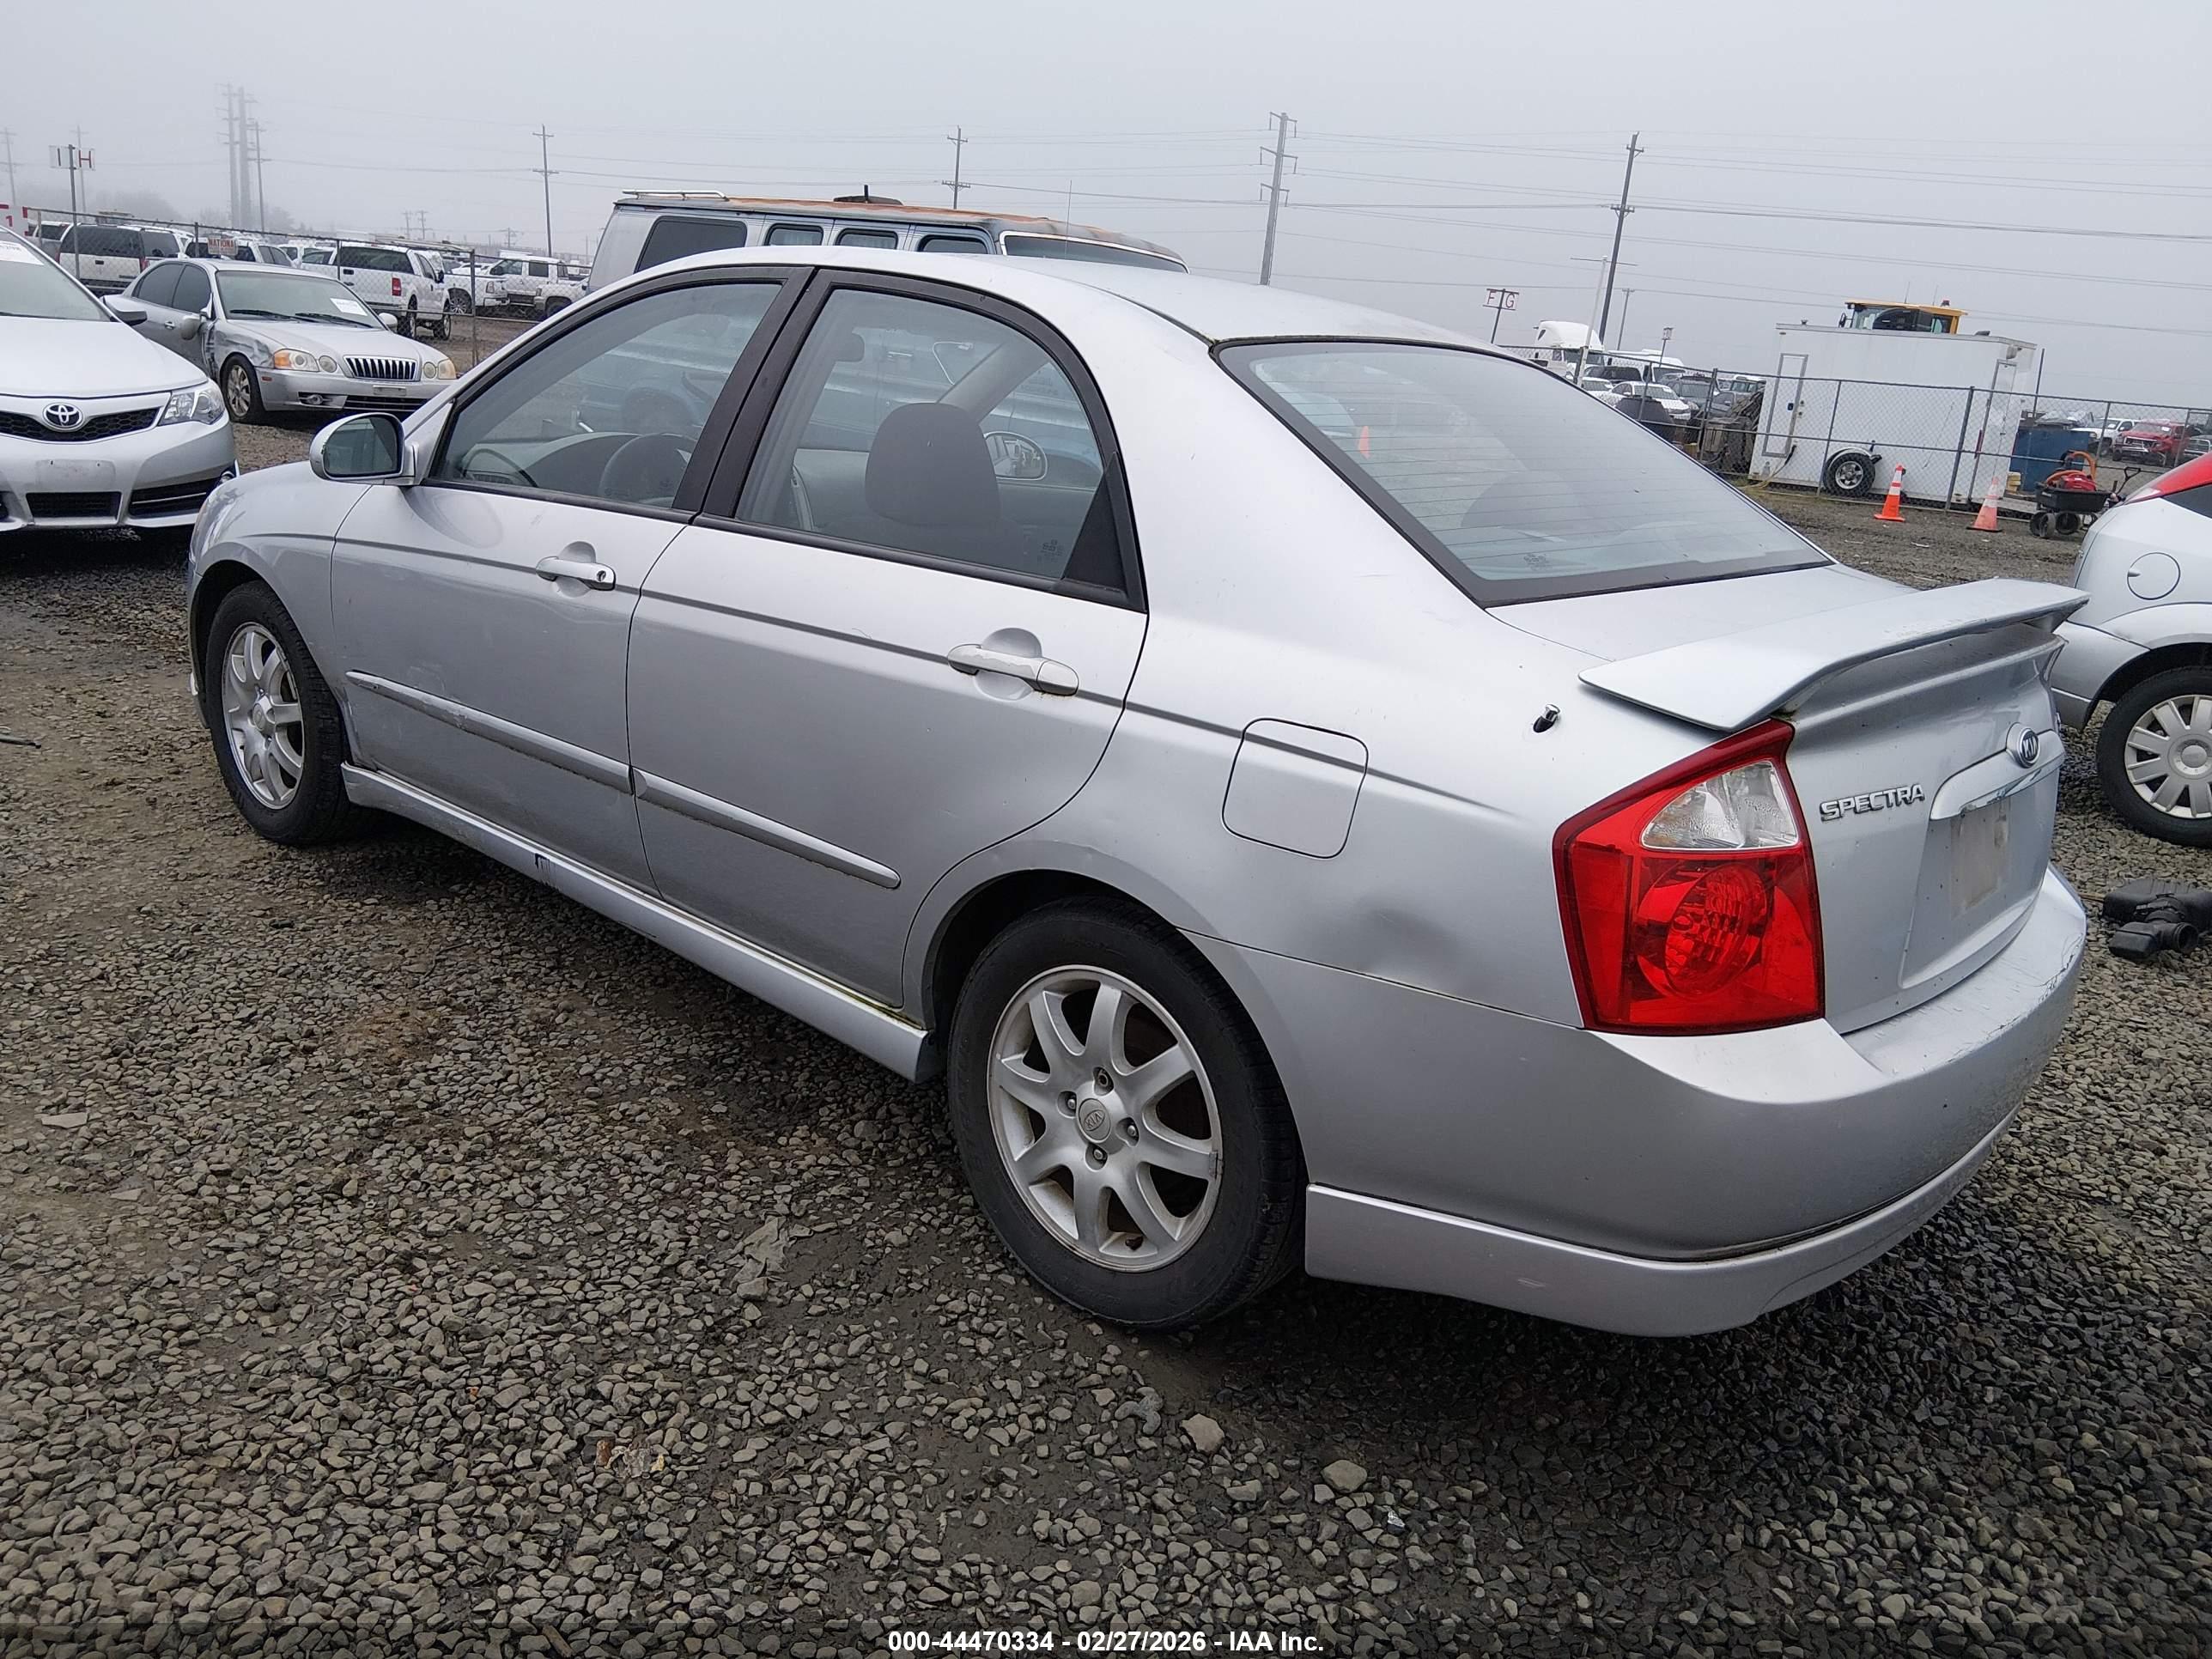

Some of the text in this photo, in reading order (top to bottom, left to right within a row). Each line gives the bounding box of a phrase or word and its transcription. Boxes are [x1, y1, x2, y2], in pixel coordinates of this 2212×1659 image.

[78, 149, 92, 169] H
[1486, 289, 1497, 305] F
[1505, 293, 1516, 308] G
[1820, 783, 1925, 822] SPECTRA
